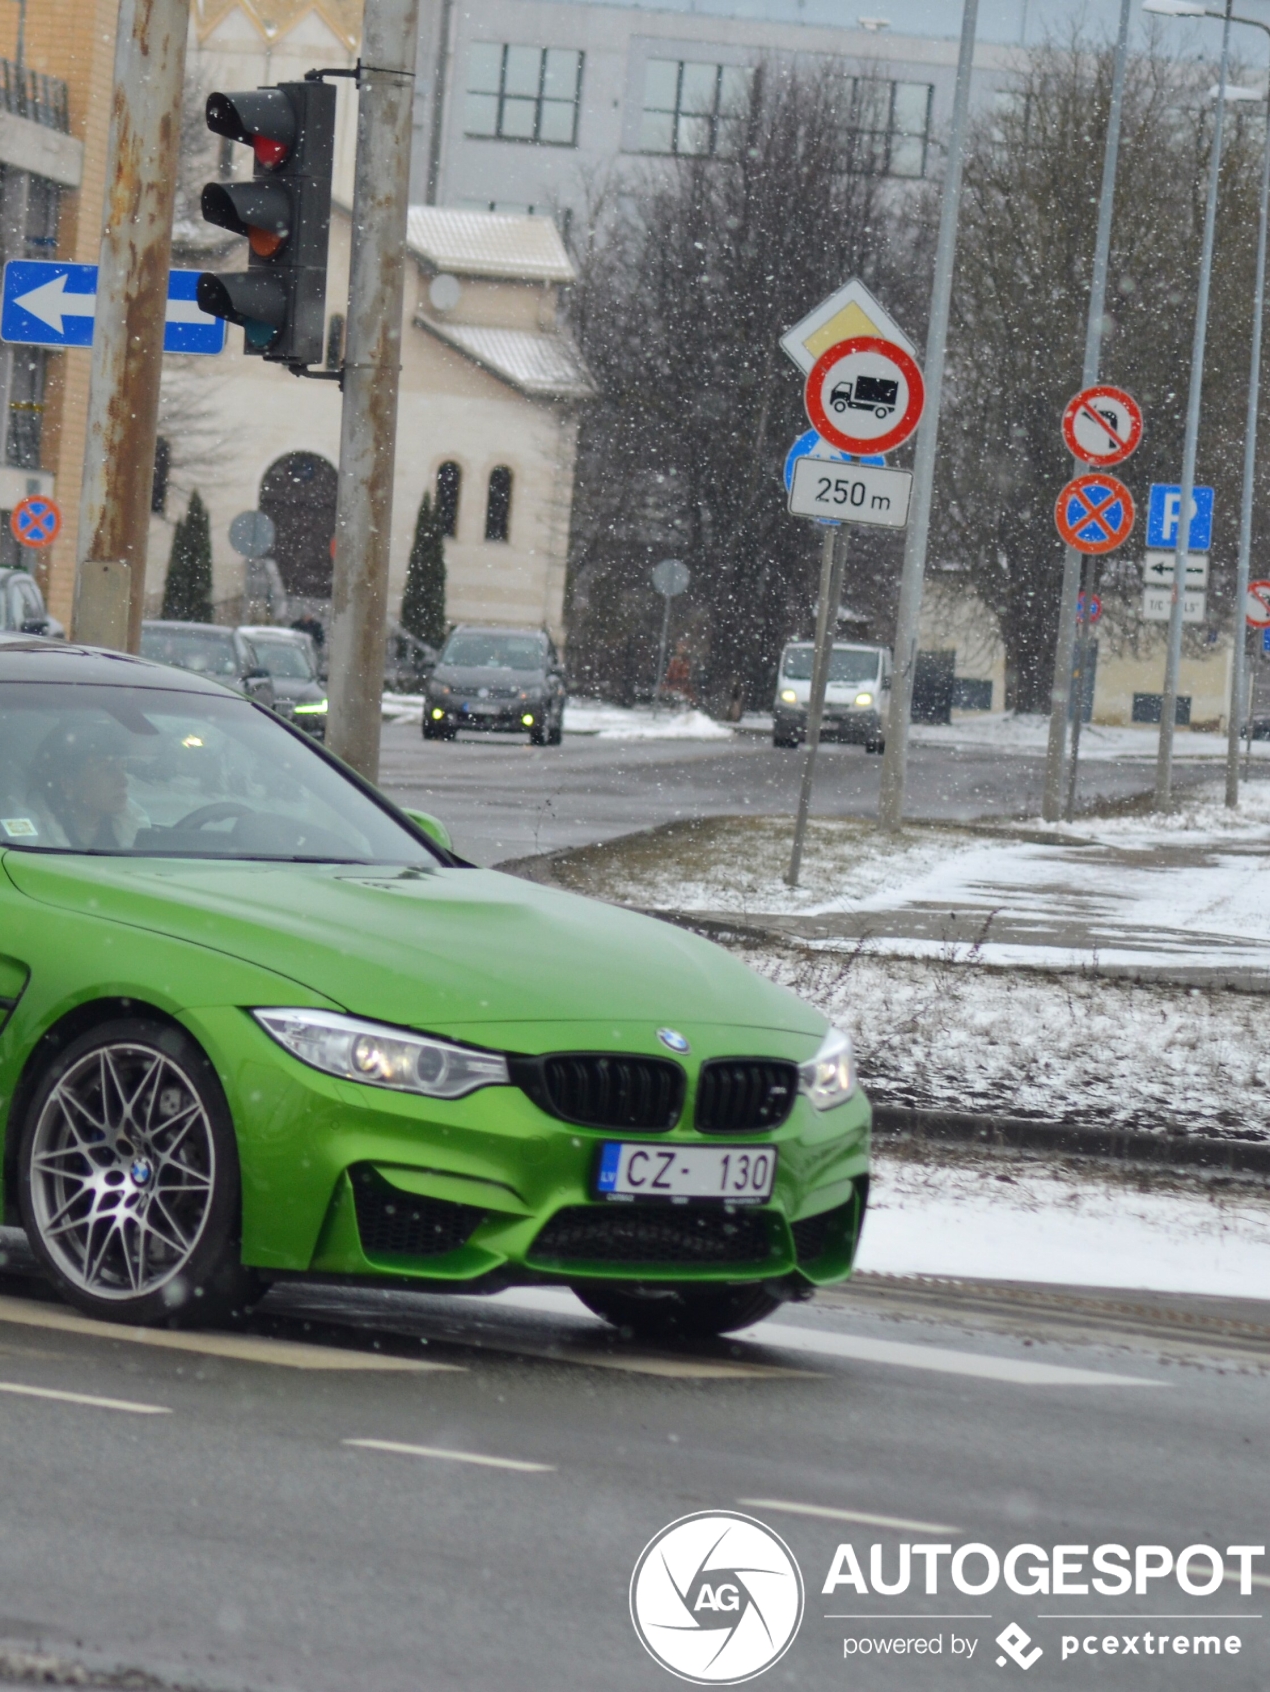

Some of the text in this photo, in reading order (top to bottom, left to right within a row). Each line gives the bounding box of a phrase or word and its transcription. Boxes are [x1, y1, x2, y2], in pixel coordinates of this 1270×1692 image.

[816, 477, 891, 511] 250 m
[1162, 493, 1198, 540] P
[1150, 599, 1164, 611] T/C
[600, 1172, 616, 1183] LV
[721, 1154, 769, 1190] 130
